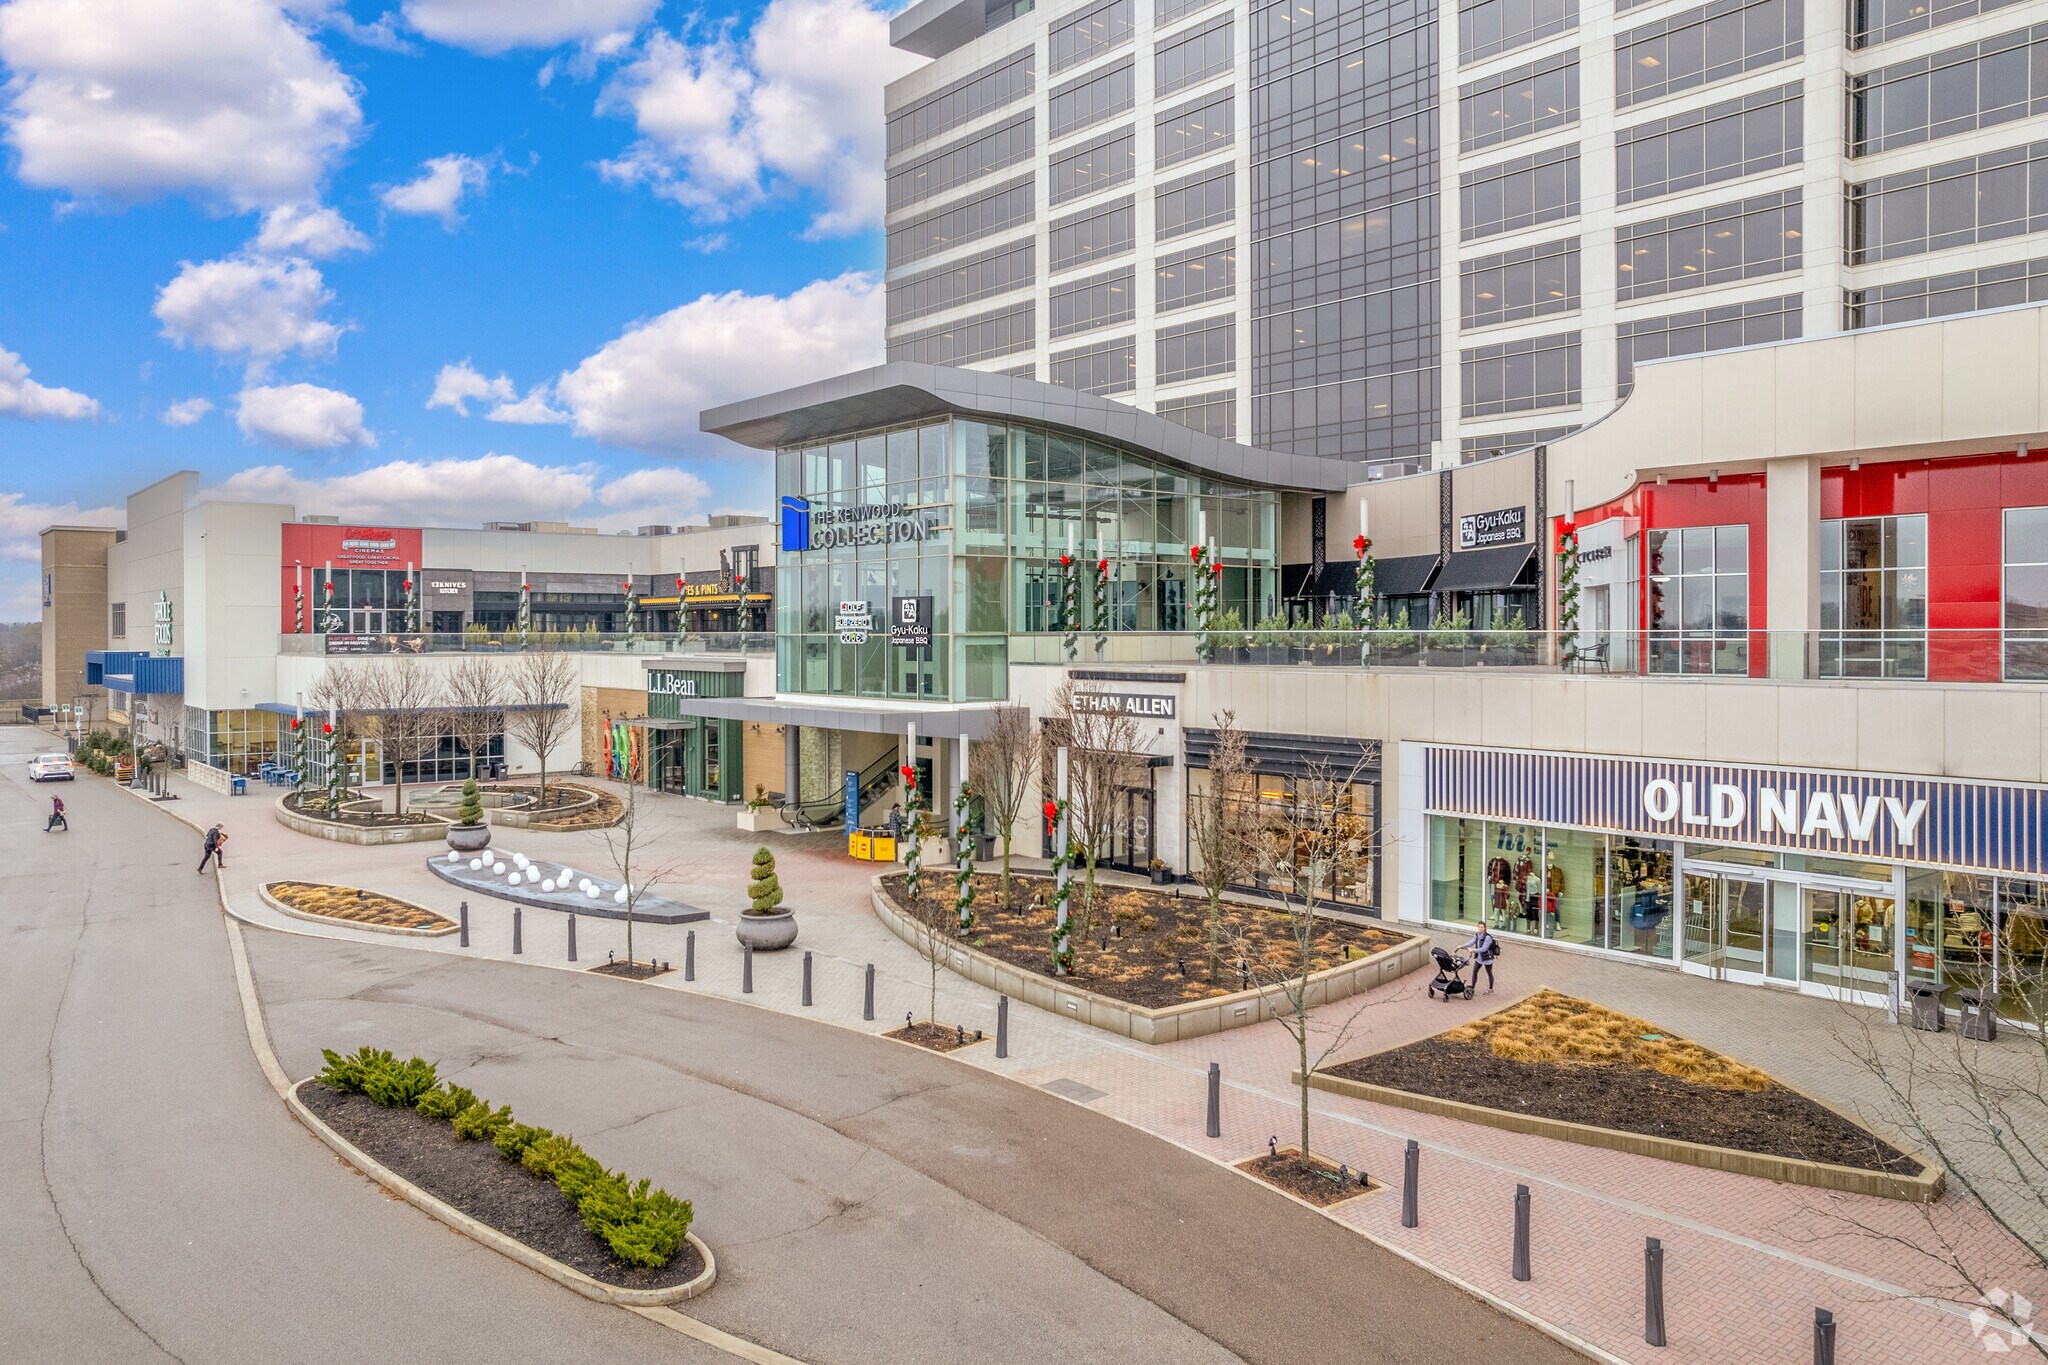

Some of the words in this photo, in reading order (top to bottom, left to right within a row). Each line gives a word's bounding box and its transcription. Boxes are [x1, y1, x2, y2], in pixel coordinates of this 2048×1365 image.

[838, 502, 901, 523] KENWOOD
[1476, 509, 1521, 531] Gyu-Kaku
[812, 519, 927, 549] COLLECTION
[1477, 531, 1505, 544] Japanese
[1506, 527, 1521, 539] BBQ
[701, 583, 718, 595] PINTS
[154, 623, 172, 644] FOODS
[890, 624, 928, 637] Gyu-Kaku
[648, 672, 697, 696] L.L.Bean
[1073, 694, 1120, 712] ETHAN
[1125, 697, 1173, 715] ALLEN
[1643, 778, 1746, 828] OLD
[1760, 787, 1929, 846] NAVY
